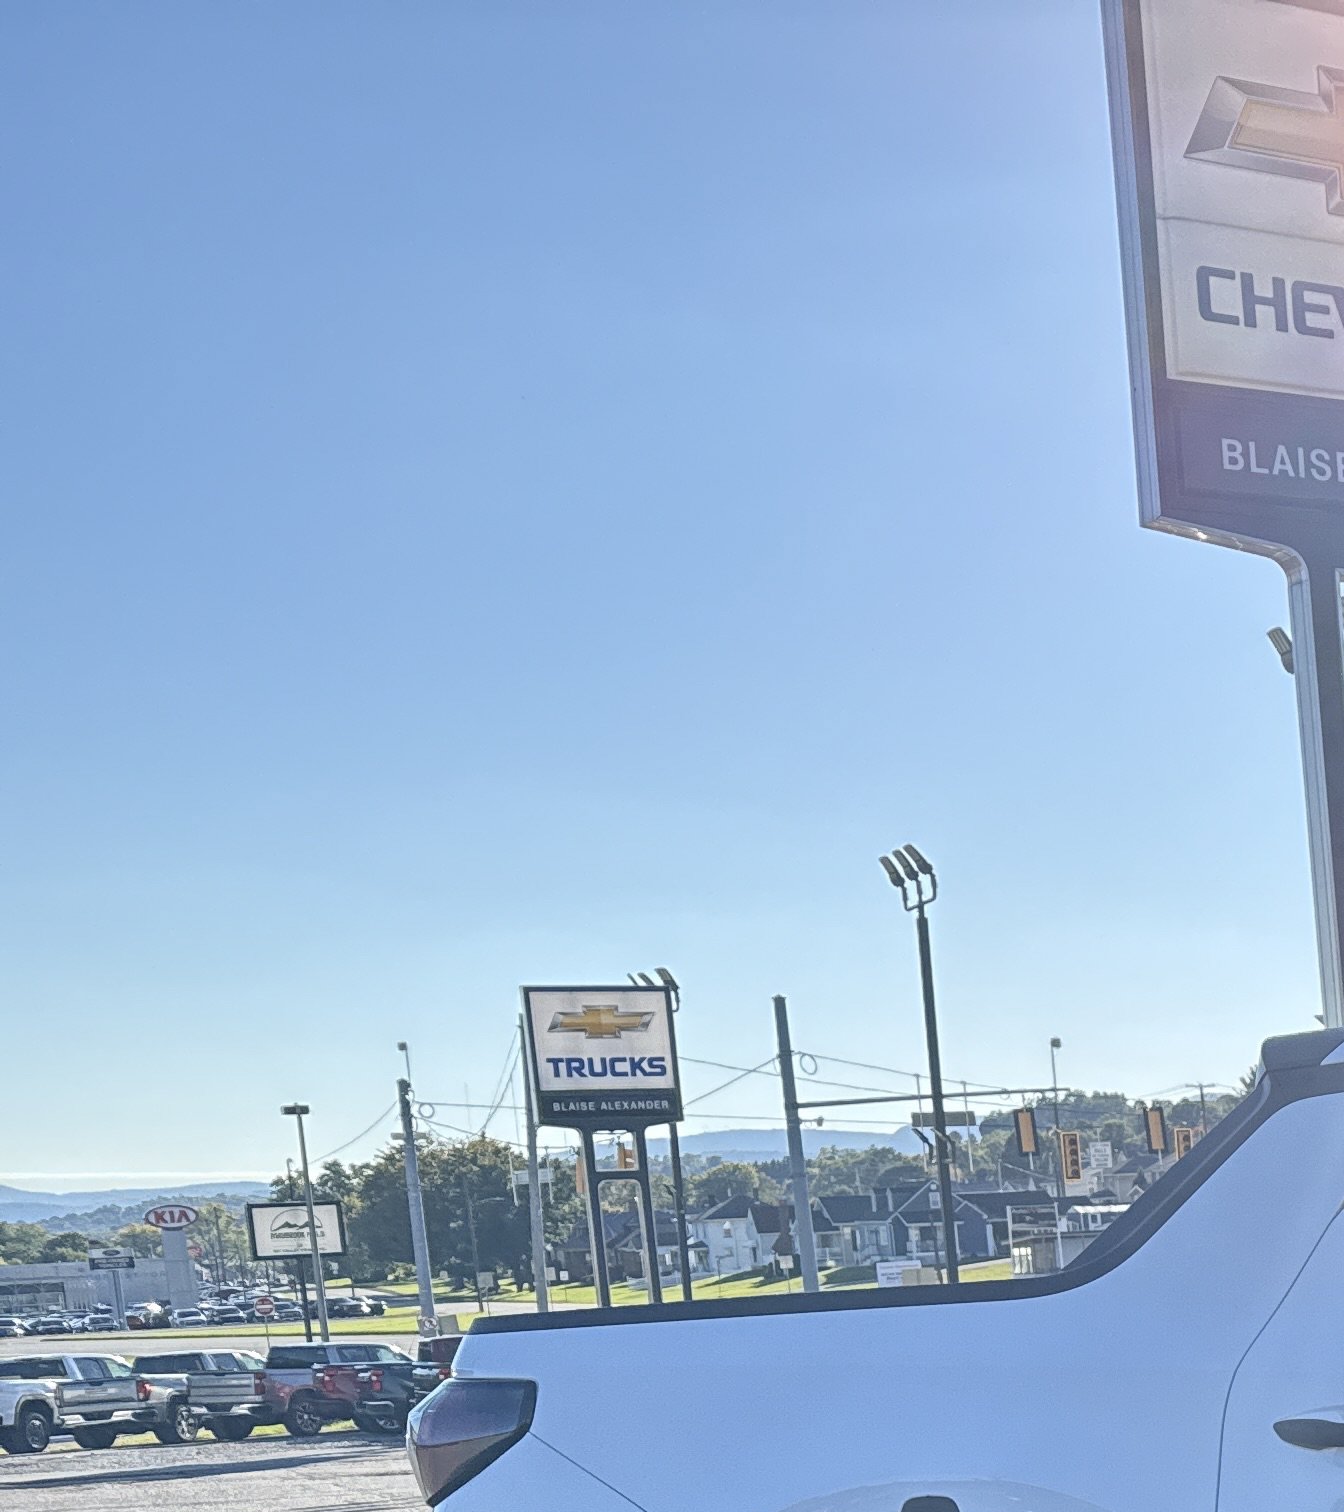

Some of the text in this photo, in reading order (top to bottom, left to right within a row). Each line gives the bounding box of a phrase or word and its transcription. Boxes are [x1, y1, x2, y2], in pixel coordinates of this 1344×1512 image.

[546, 1056, 667, 1078] TRUCKS
[552, 1100, 669, 1112] BLAISE ALEXANDER
[153, 1210, 191, 1224] KIA
